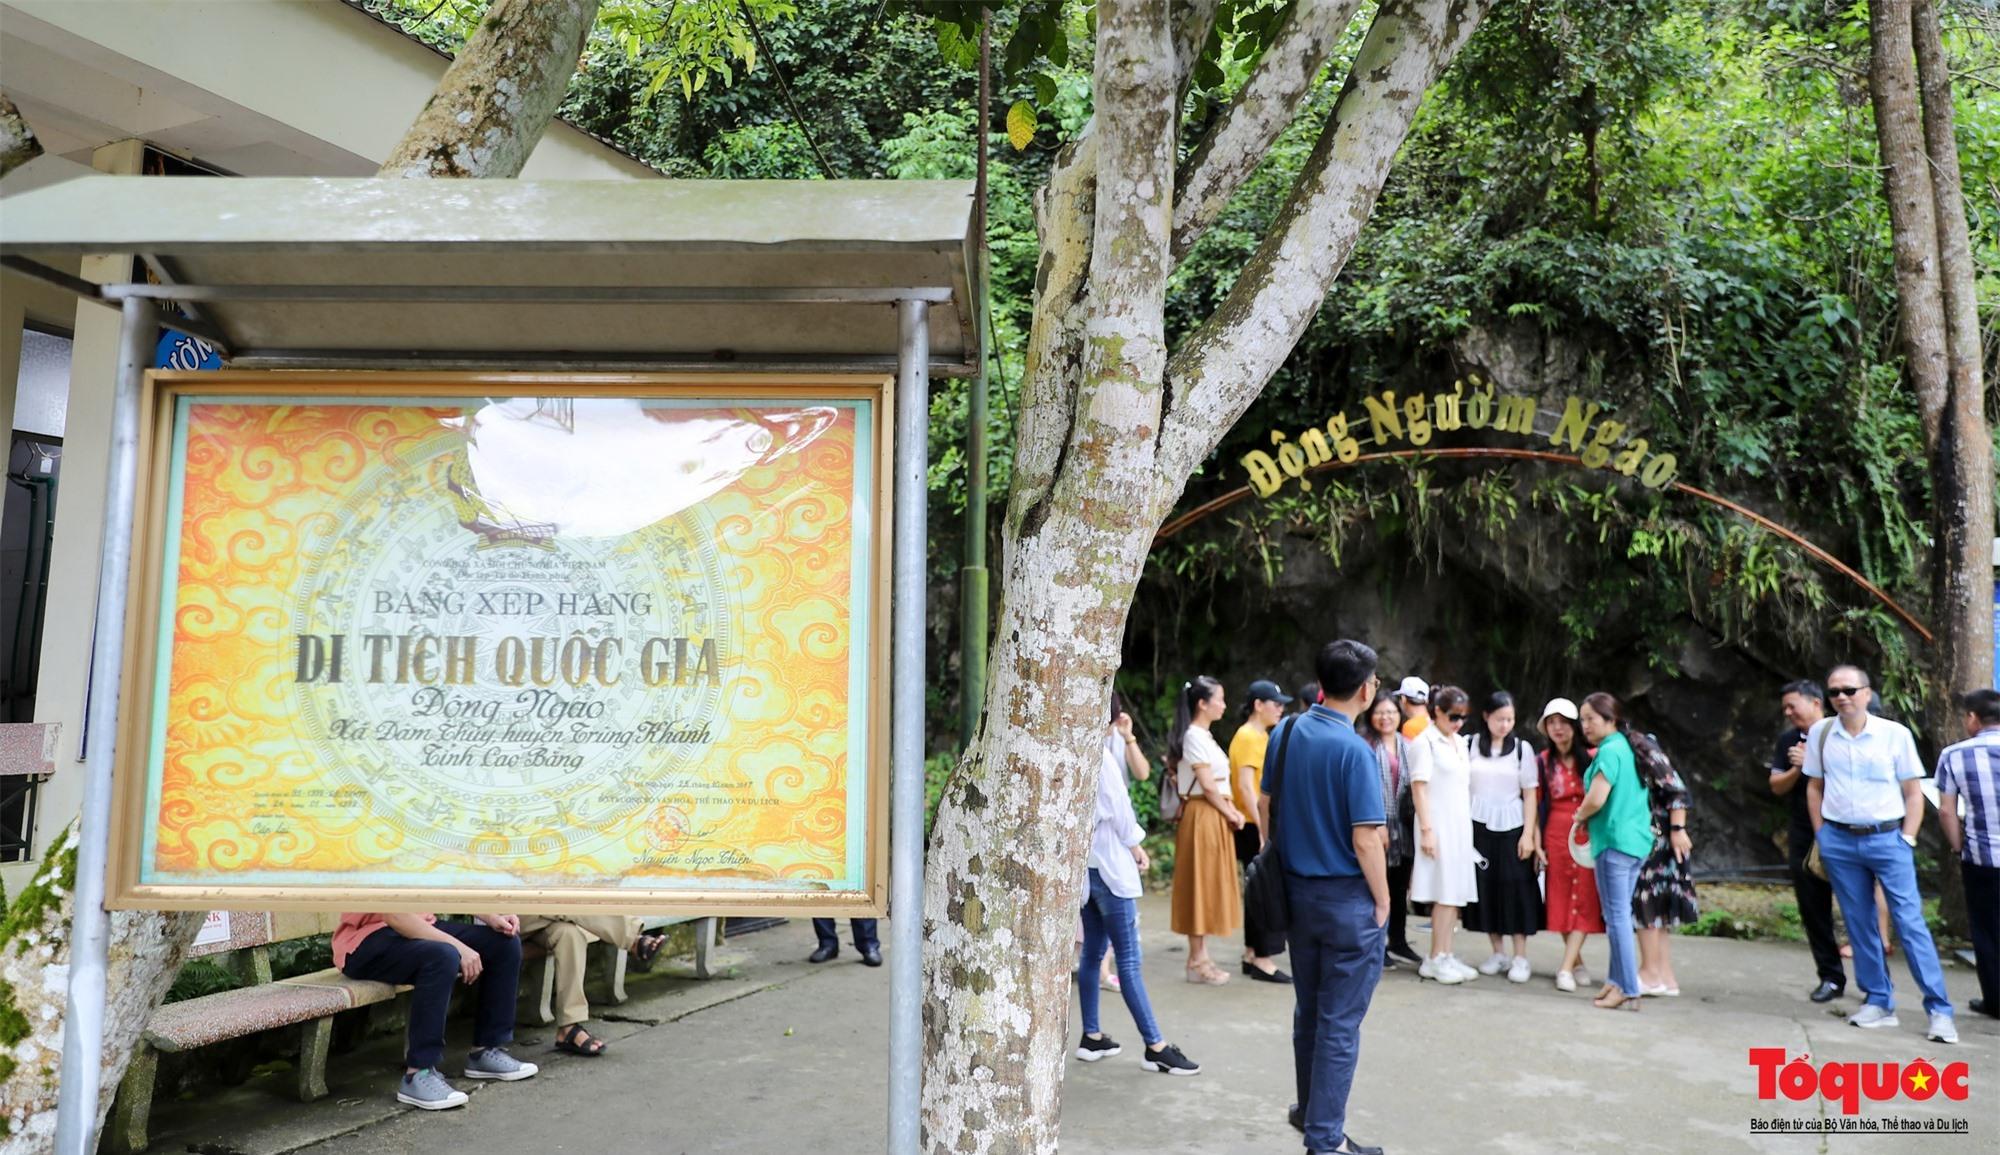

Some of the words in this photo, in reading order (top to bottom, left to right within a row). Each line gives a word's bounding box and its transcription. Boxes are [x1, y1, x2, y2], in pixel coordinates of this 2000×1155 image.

[1240, 411, 1360, 497] Động
[1363, 373, 1536, 446] Ngườm
[1548, 396, 1678, 488] Ngao
[294, 634, 346, 683] DI
[640, 637, 723, 688] GIA
[480, 746, 519, 768] Cao
